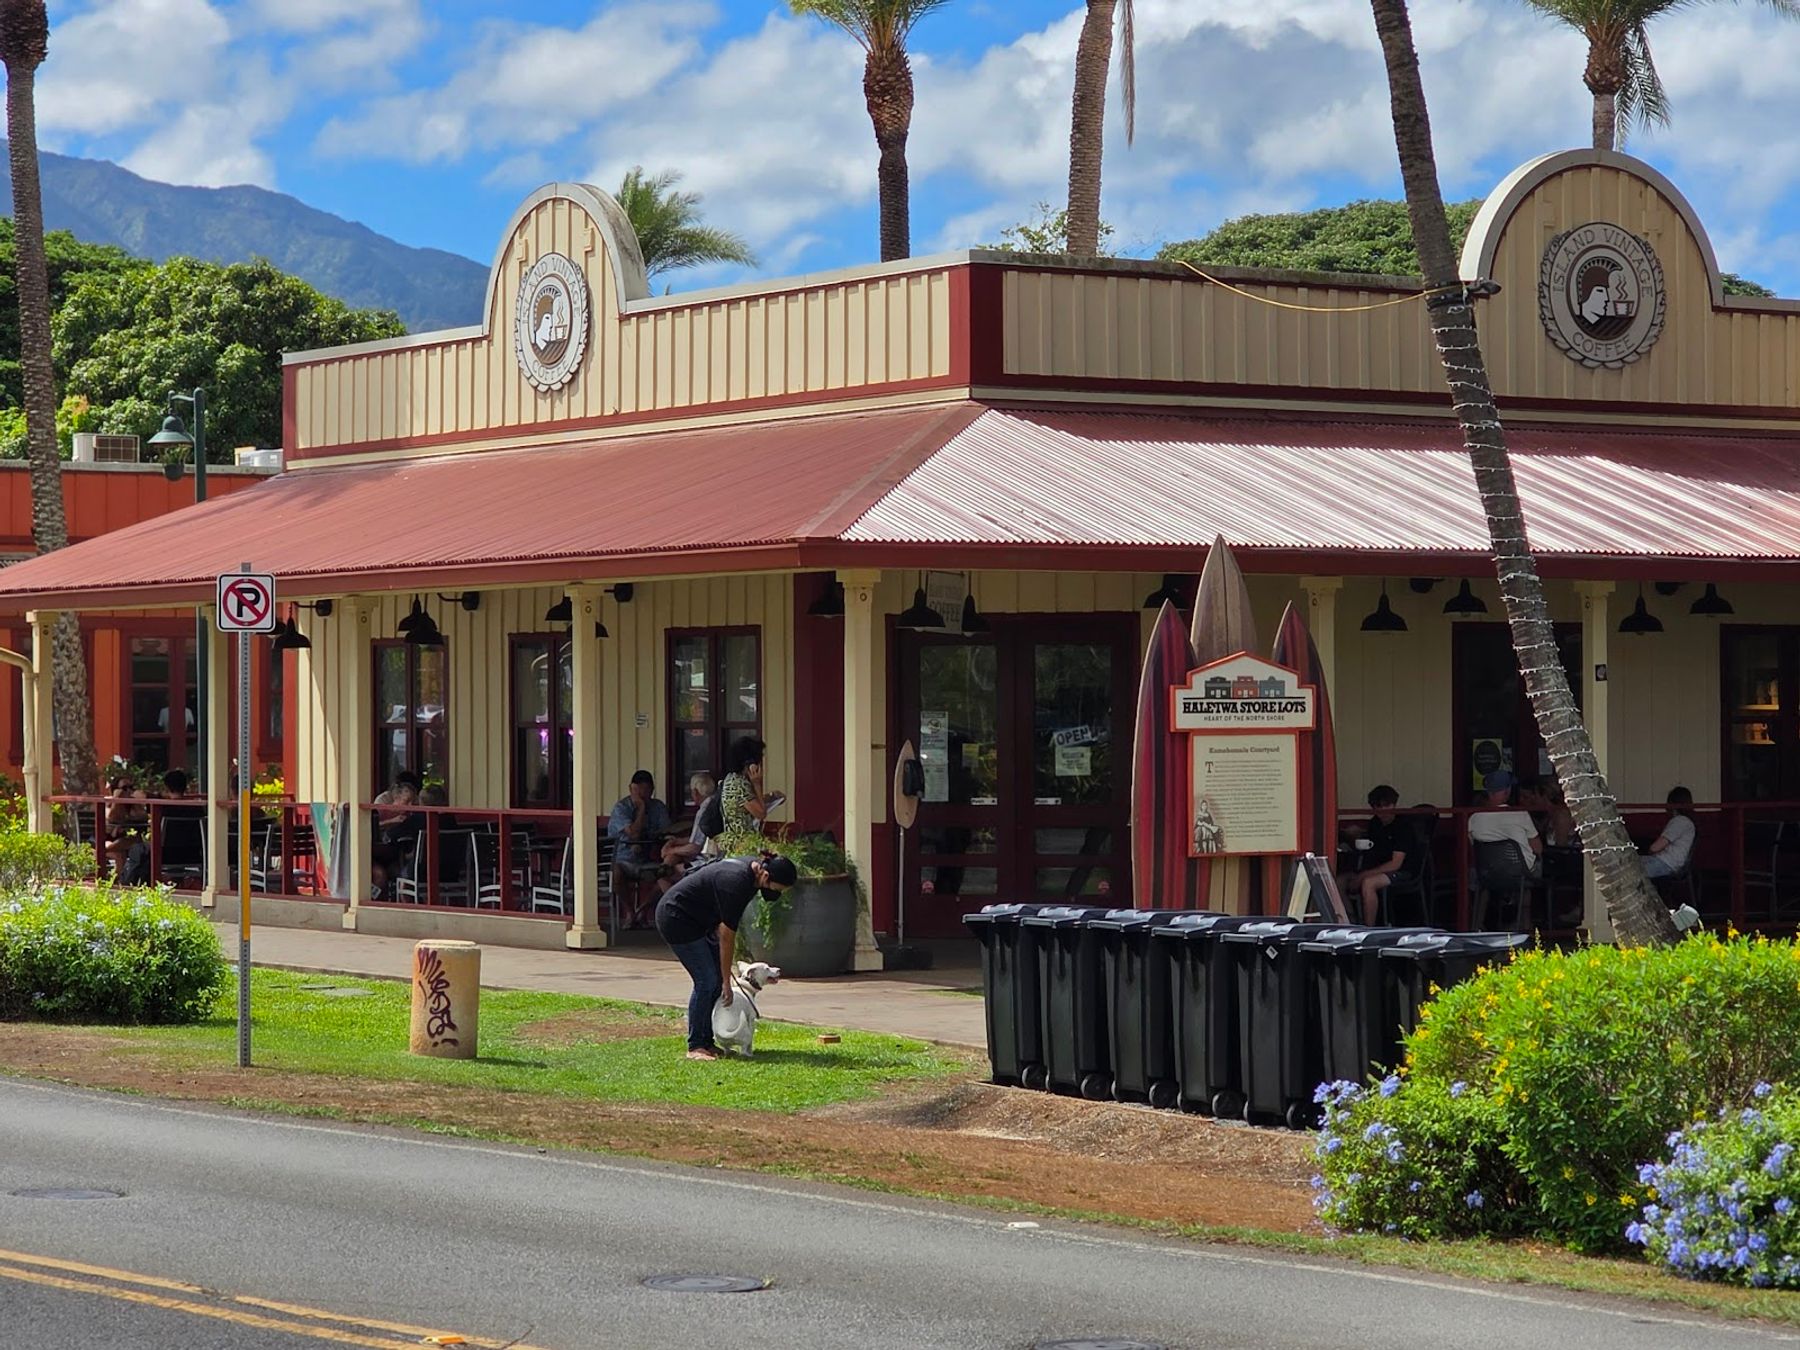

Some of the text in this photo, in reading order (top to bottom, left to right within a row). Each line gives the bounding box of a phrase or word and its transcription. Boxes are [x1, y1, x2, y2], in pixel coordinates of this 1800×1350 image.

[1553, 228, 1653, 298] ISLAND VINTAGE
[522, 257, 581, 325] ISLAND VINTAGE
[1572, 331, 1635, 358] COFFEE
[533, 355, 569, 381] COFFEE
[1239, 701, 1277, 714] STORE
[1278, 701, 1306, 714] LOTS
[1056, 727, 1090, 746] OPEN
